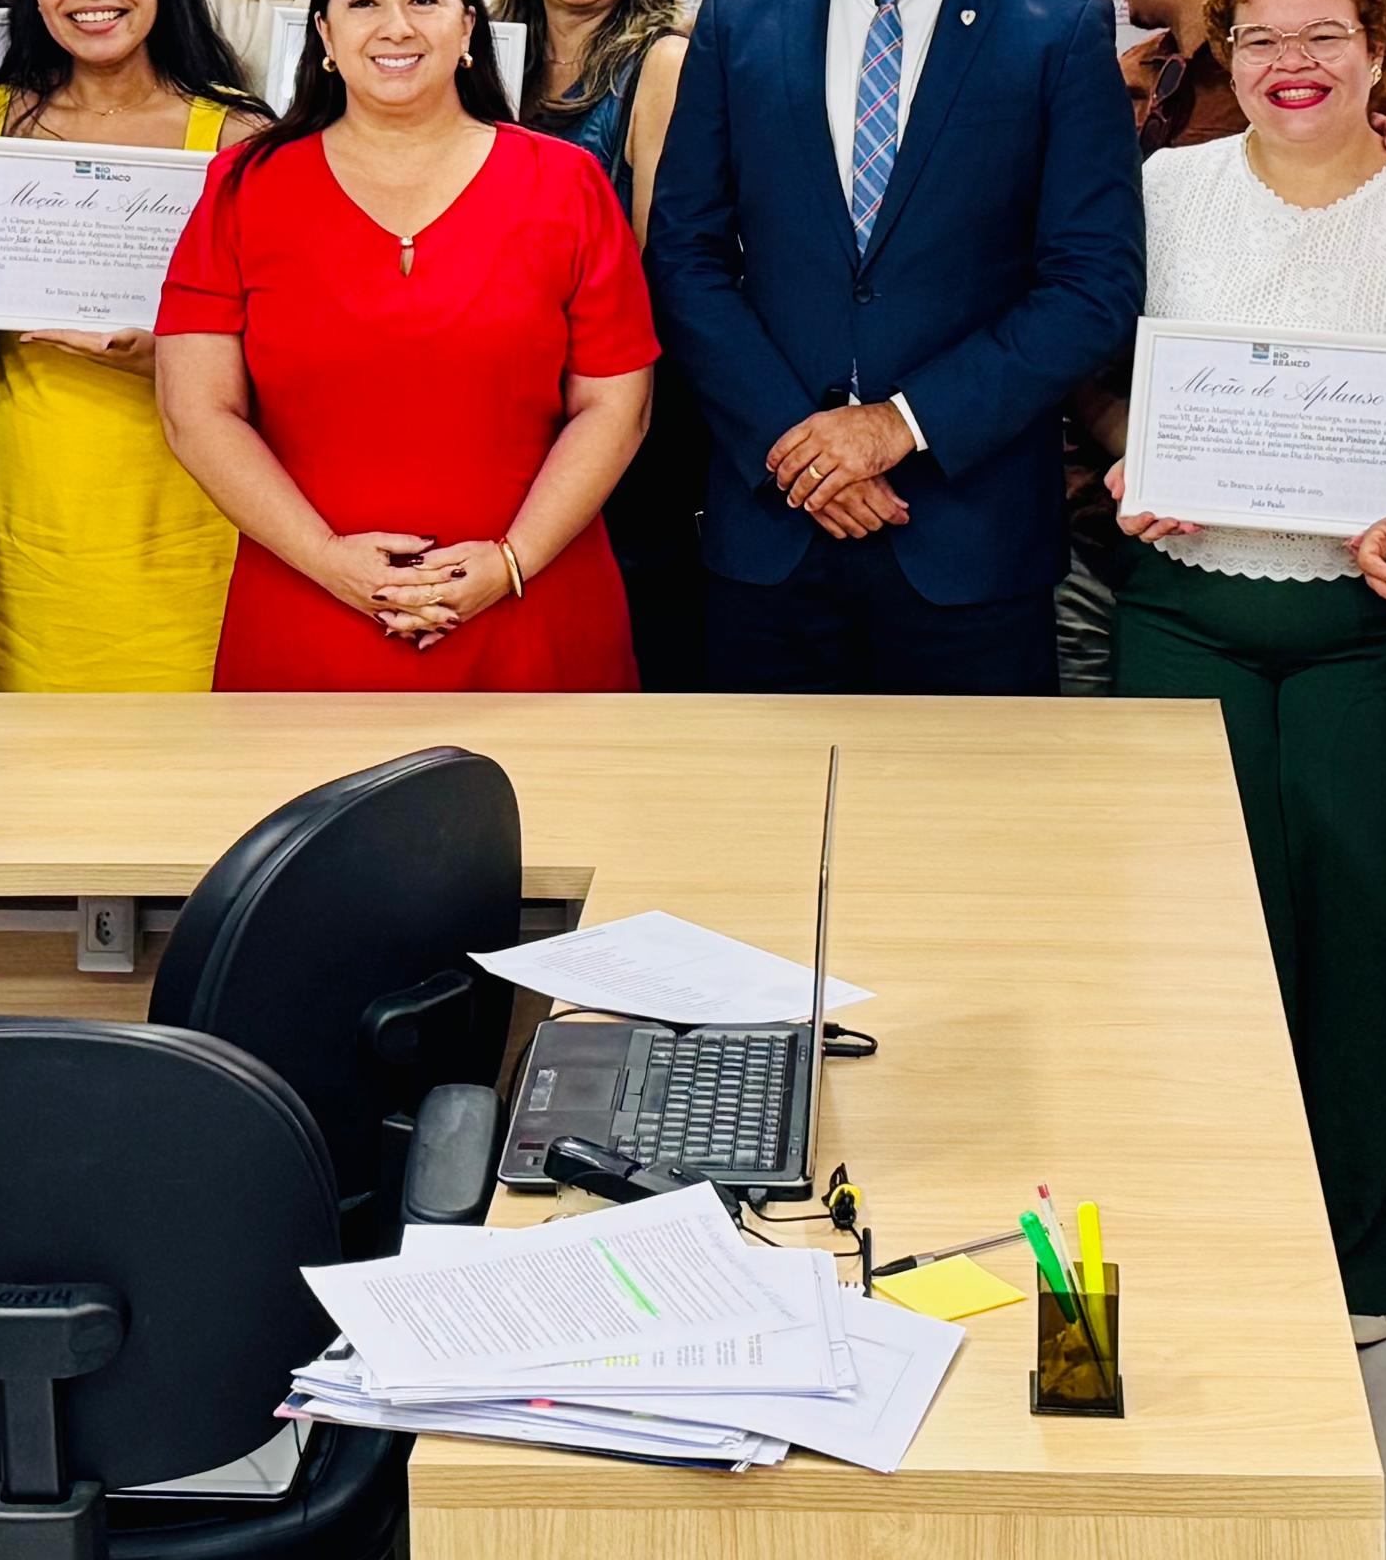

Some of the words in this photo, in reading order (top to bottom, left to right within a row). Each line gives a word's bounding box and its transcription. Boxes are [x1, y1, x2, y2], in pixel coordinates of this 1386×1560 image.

[95, 174, 131, 182] BRANCO
[75, 189, 99, 208] de
[106, 189, 190, 222] Aplaus
[1273, 359, 1310, 367] BRANCO
[1170, 367, 1245, 397] Moção
[1251, 376, 1276, 397] de
[1284, 375, 1384, 411] Aplauso
